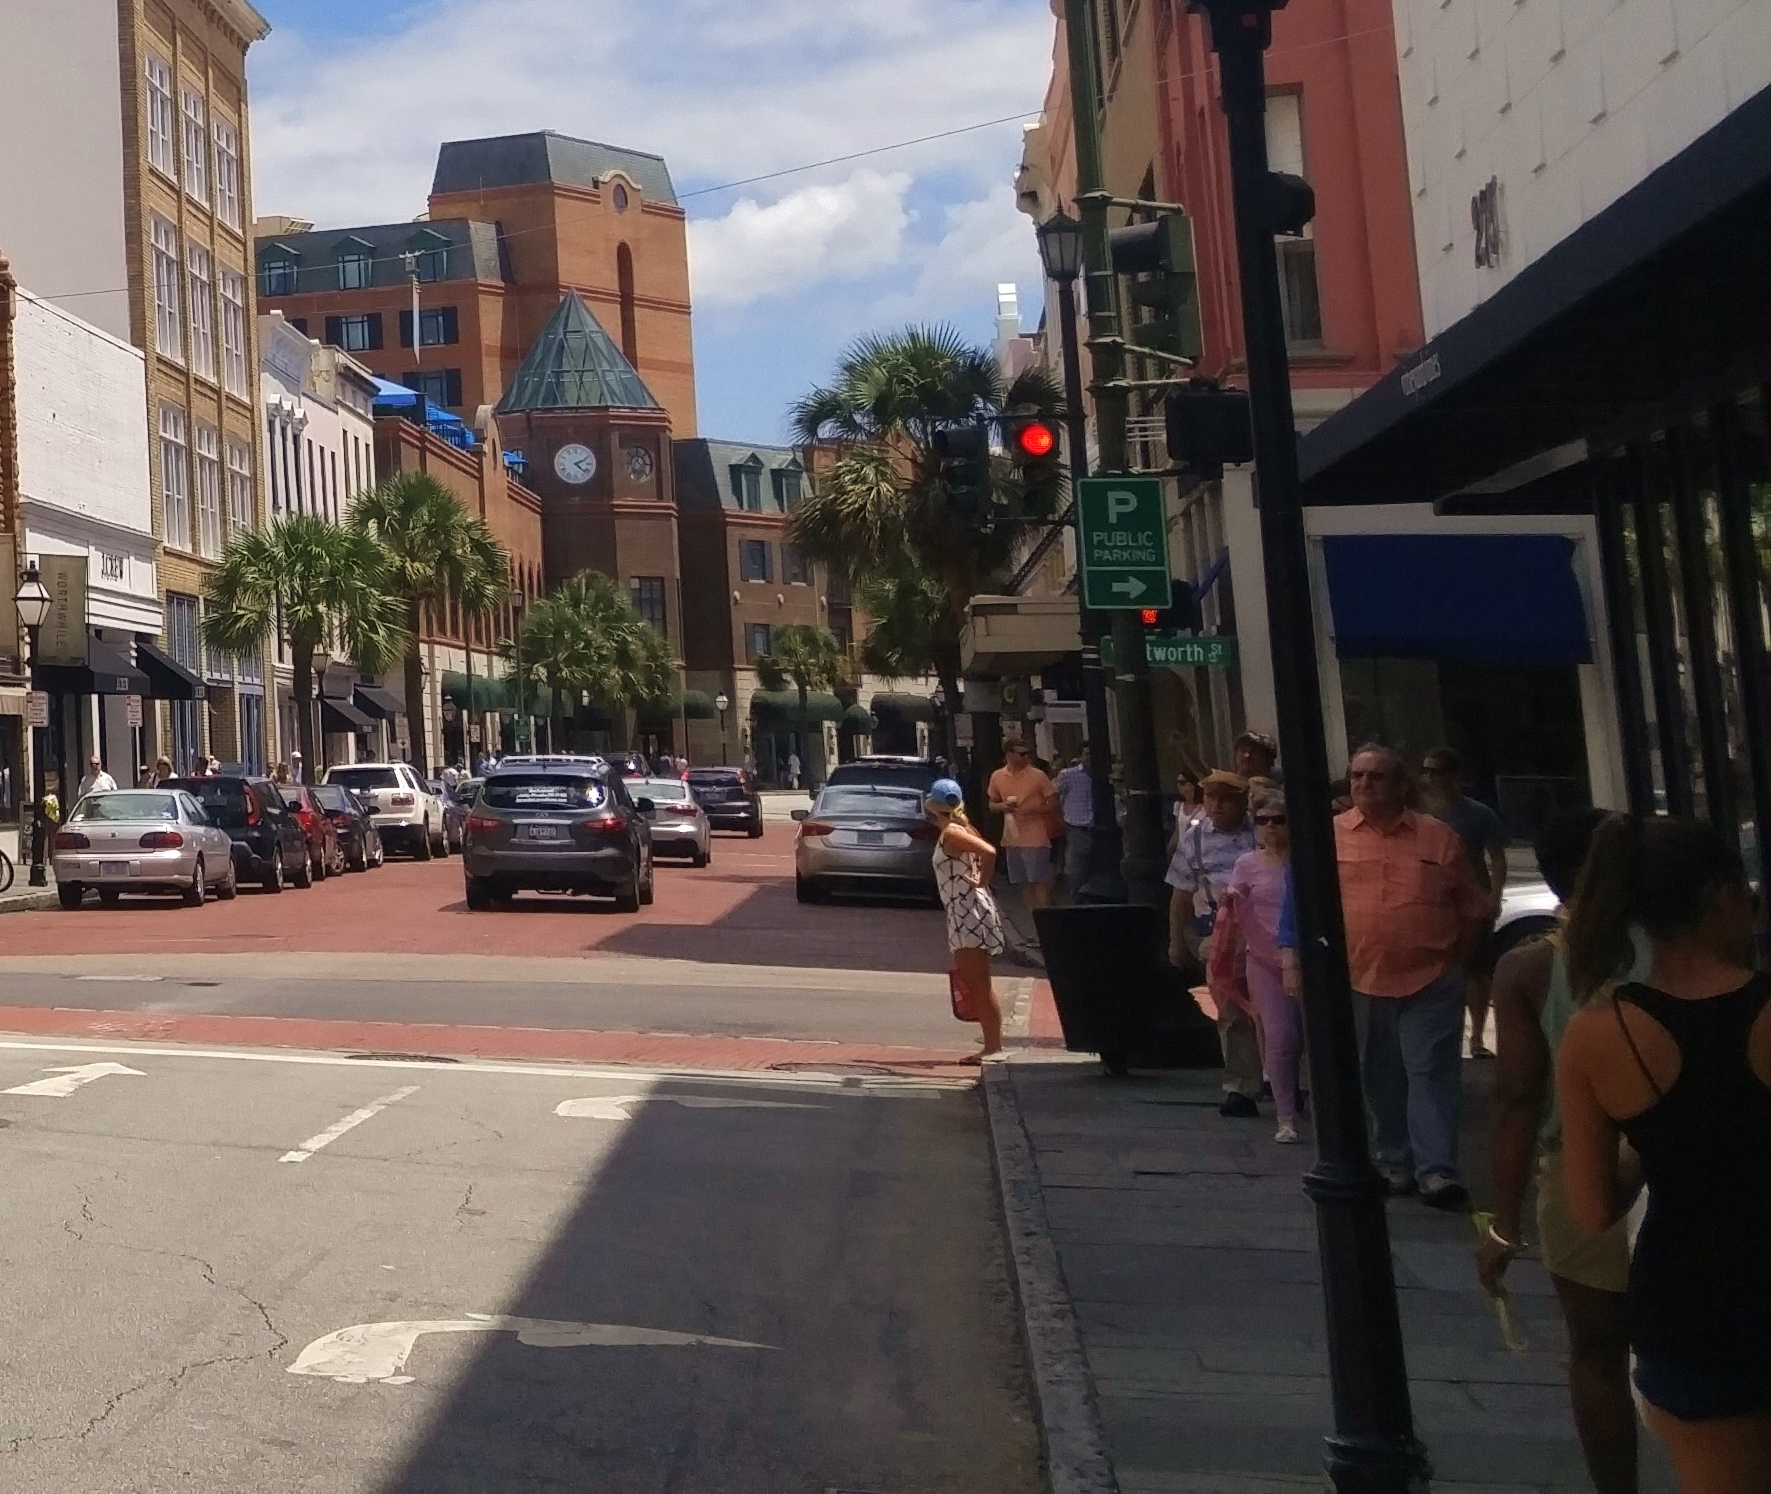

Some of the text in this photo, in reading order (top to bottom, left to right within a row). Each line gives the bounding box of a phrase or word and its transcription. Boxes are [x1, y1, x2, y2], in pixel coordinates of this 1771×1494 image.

[1106, 491, 1138, 524] P
[1093, 531, 1154, 546] PUBLIC
[1093, 548, 1156, 562] PARKING
[56, 572, 68, 647] WORTHWHILE
